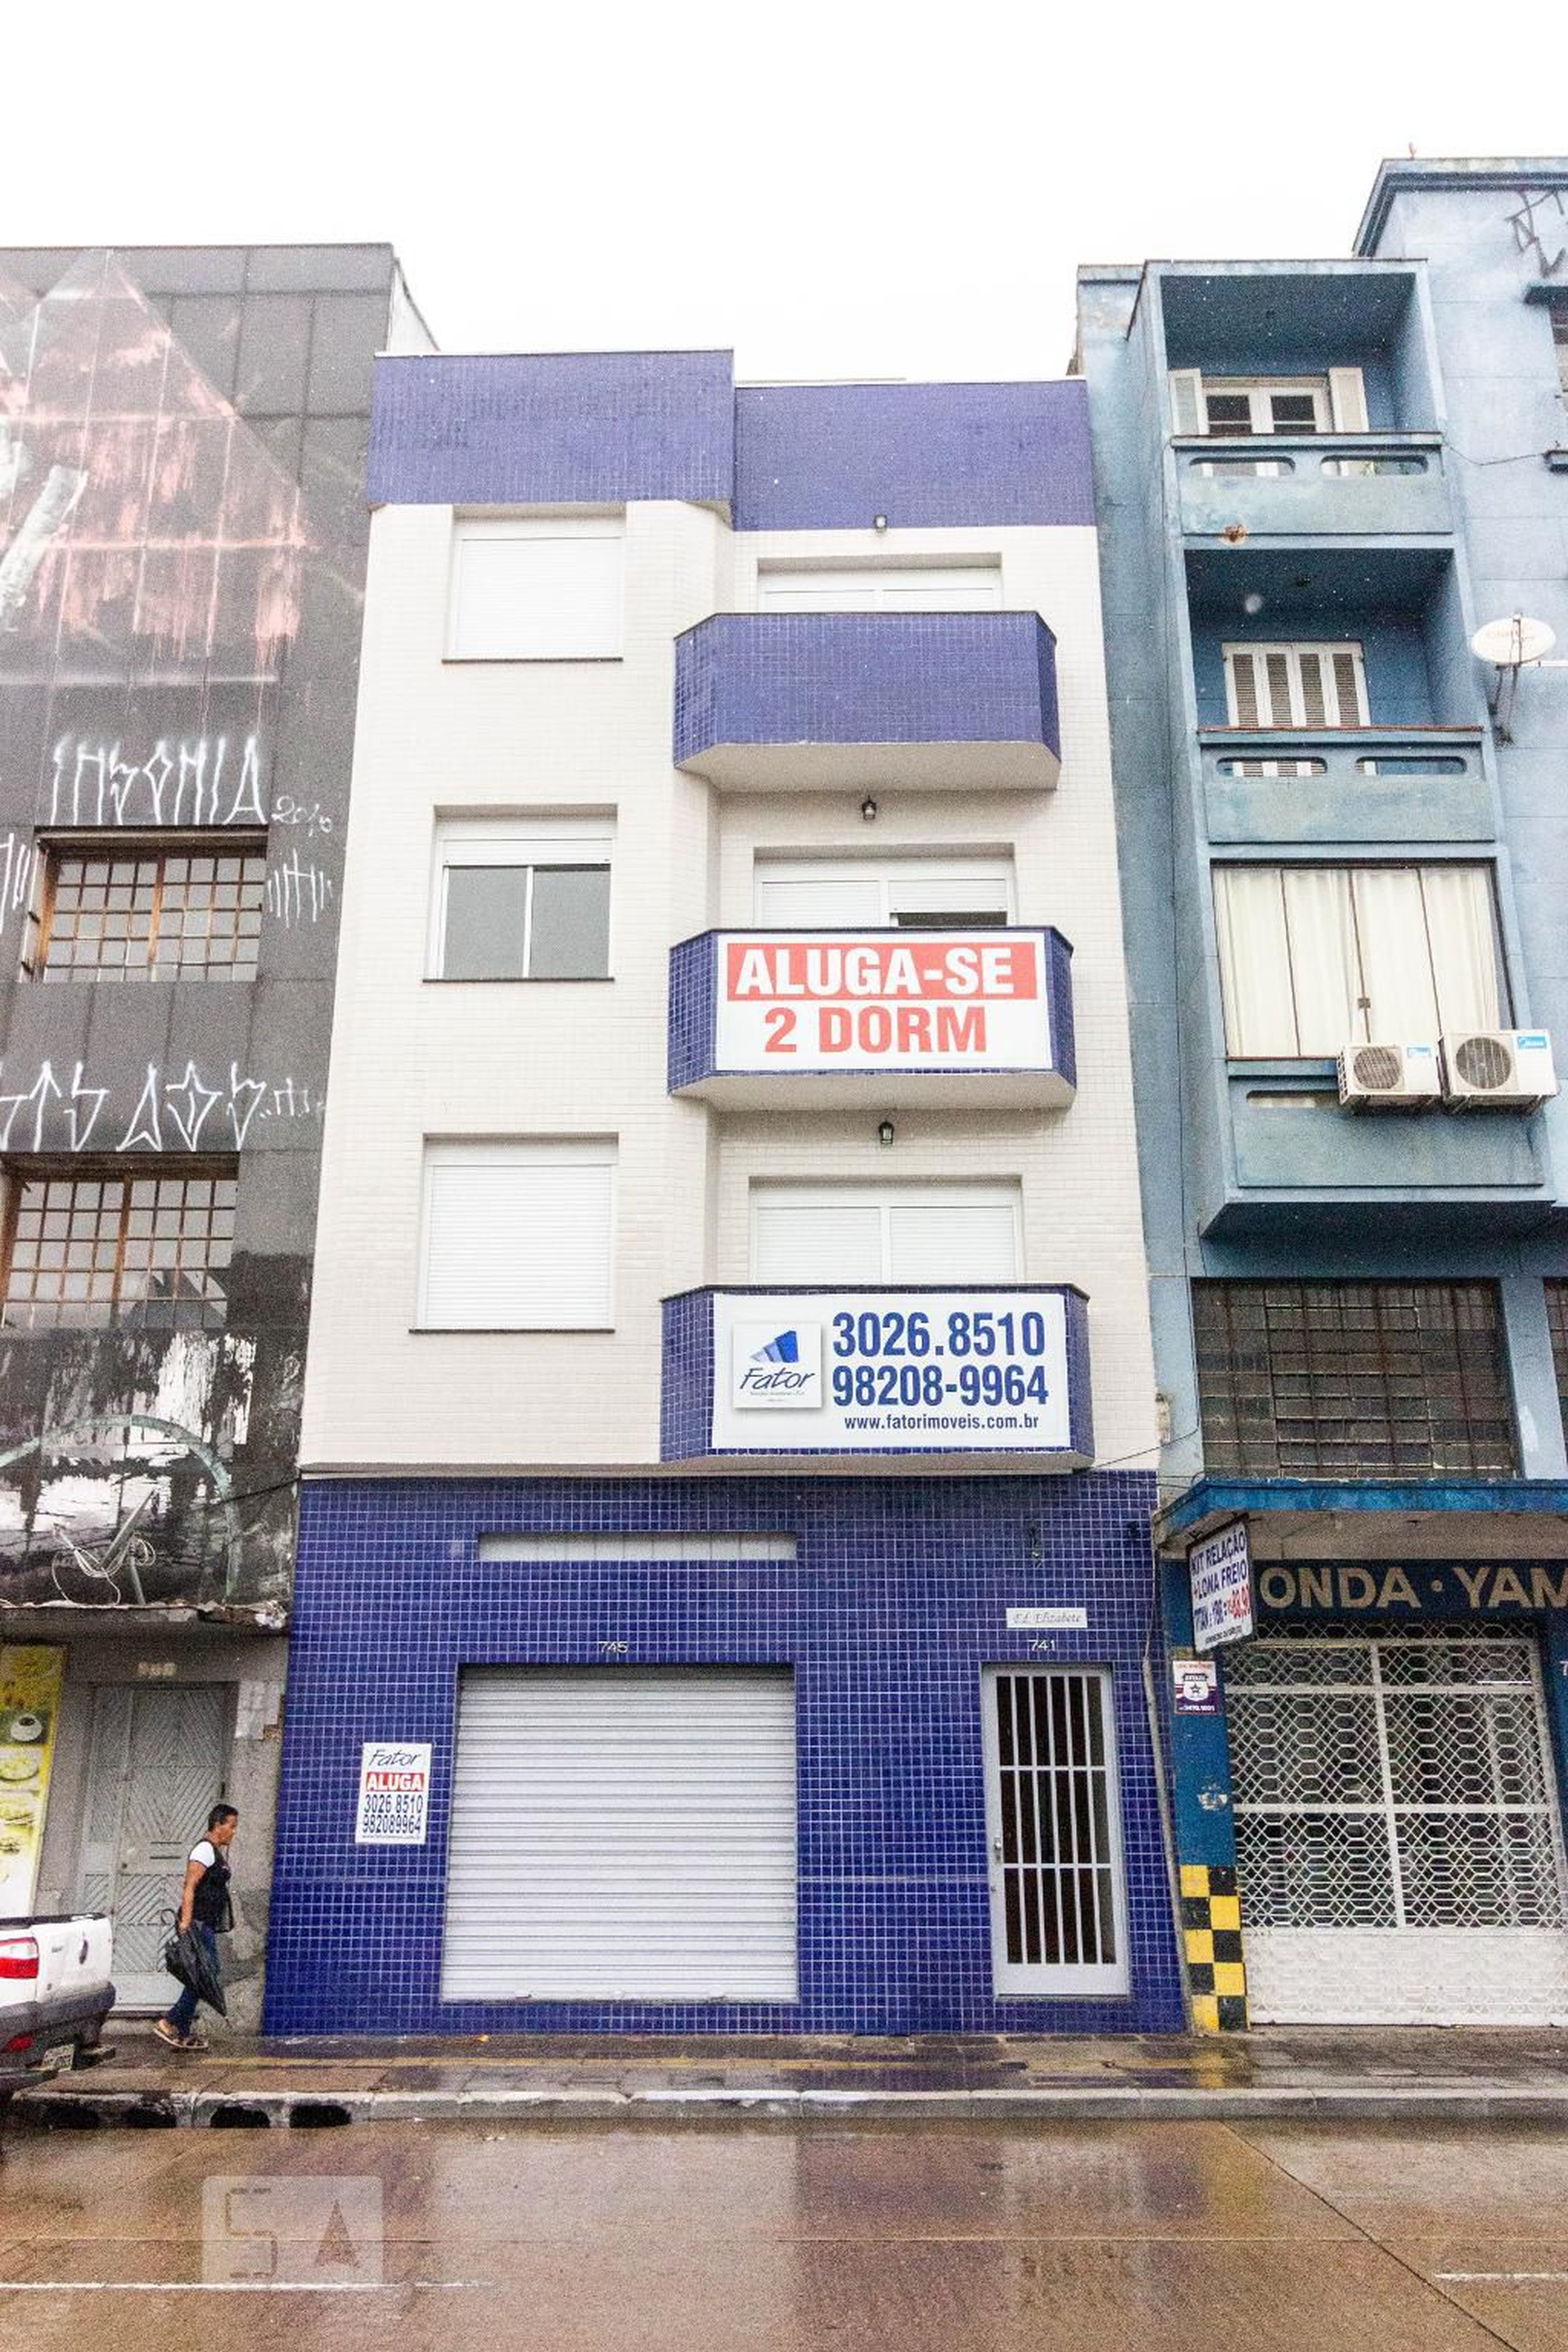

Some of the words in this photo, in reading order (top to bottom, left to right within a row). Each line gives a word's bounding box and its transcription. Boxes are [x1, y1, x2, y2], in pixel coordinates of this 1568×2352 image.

[735, 947, 1014, 996] ALUGA-SE
[764, 1007, 797, 1053] 2
[819, 1005, 987, 1054] DORM
[833, 1312, 1045, 1357] 3026.8510
[739, 1367, 816, 1390] Fator
[833, 1364, 1049, 1406] 98208-9964
[844, 1414, 1039, 1429] www.fatorimoveis.com.br
[1221, 1559, 1247, 1589] FREIO
[1259, 1567, 1421, 1610] ONDA
[598, 1641, 628, 1653] 745
[1029, 1639, 1055, 1651] 741
[368, 1749, 421, 1766] Fator
[367, 1773, 423, 1790] ALUGA
